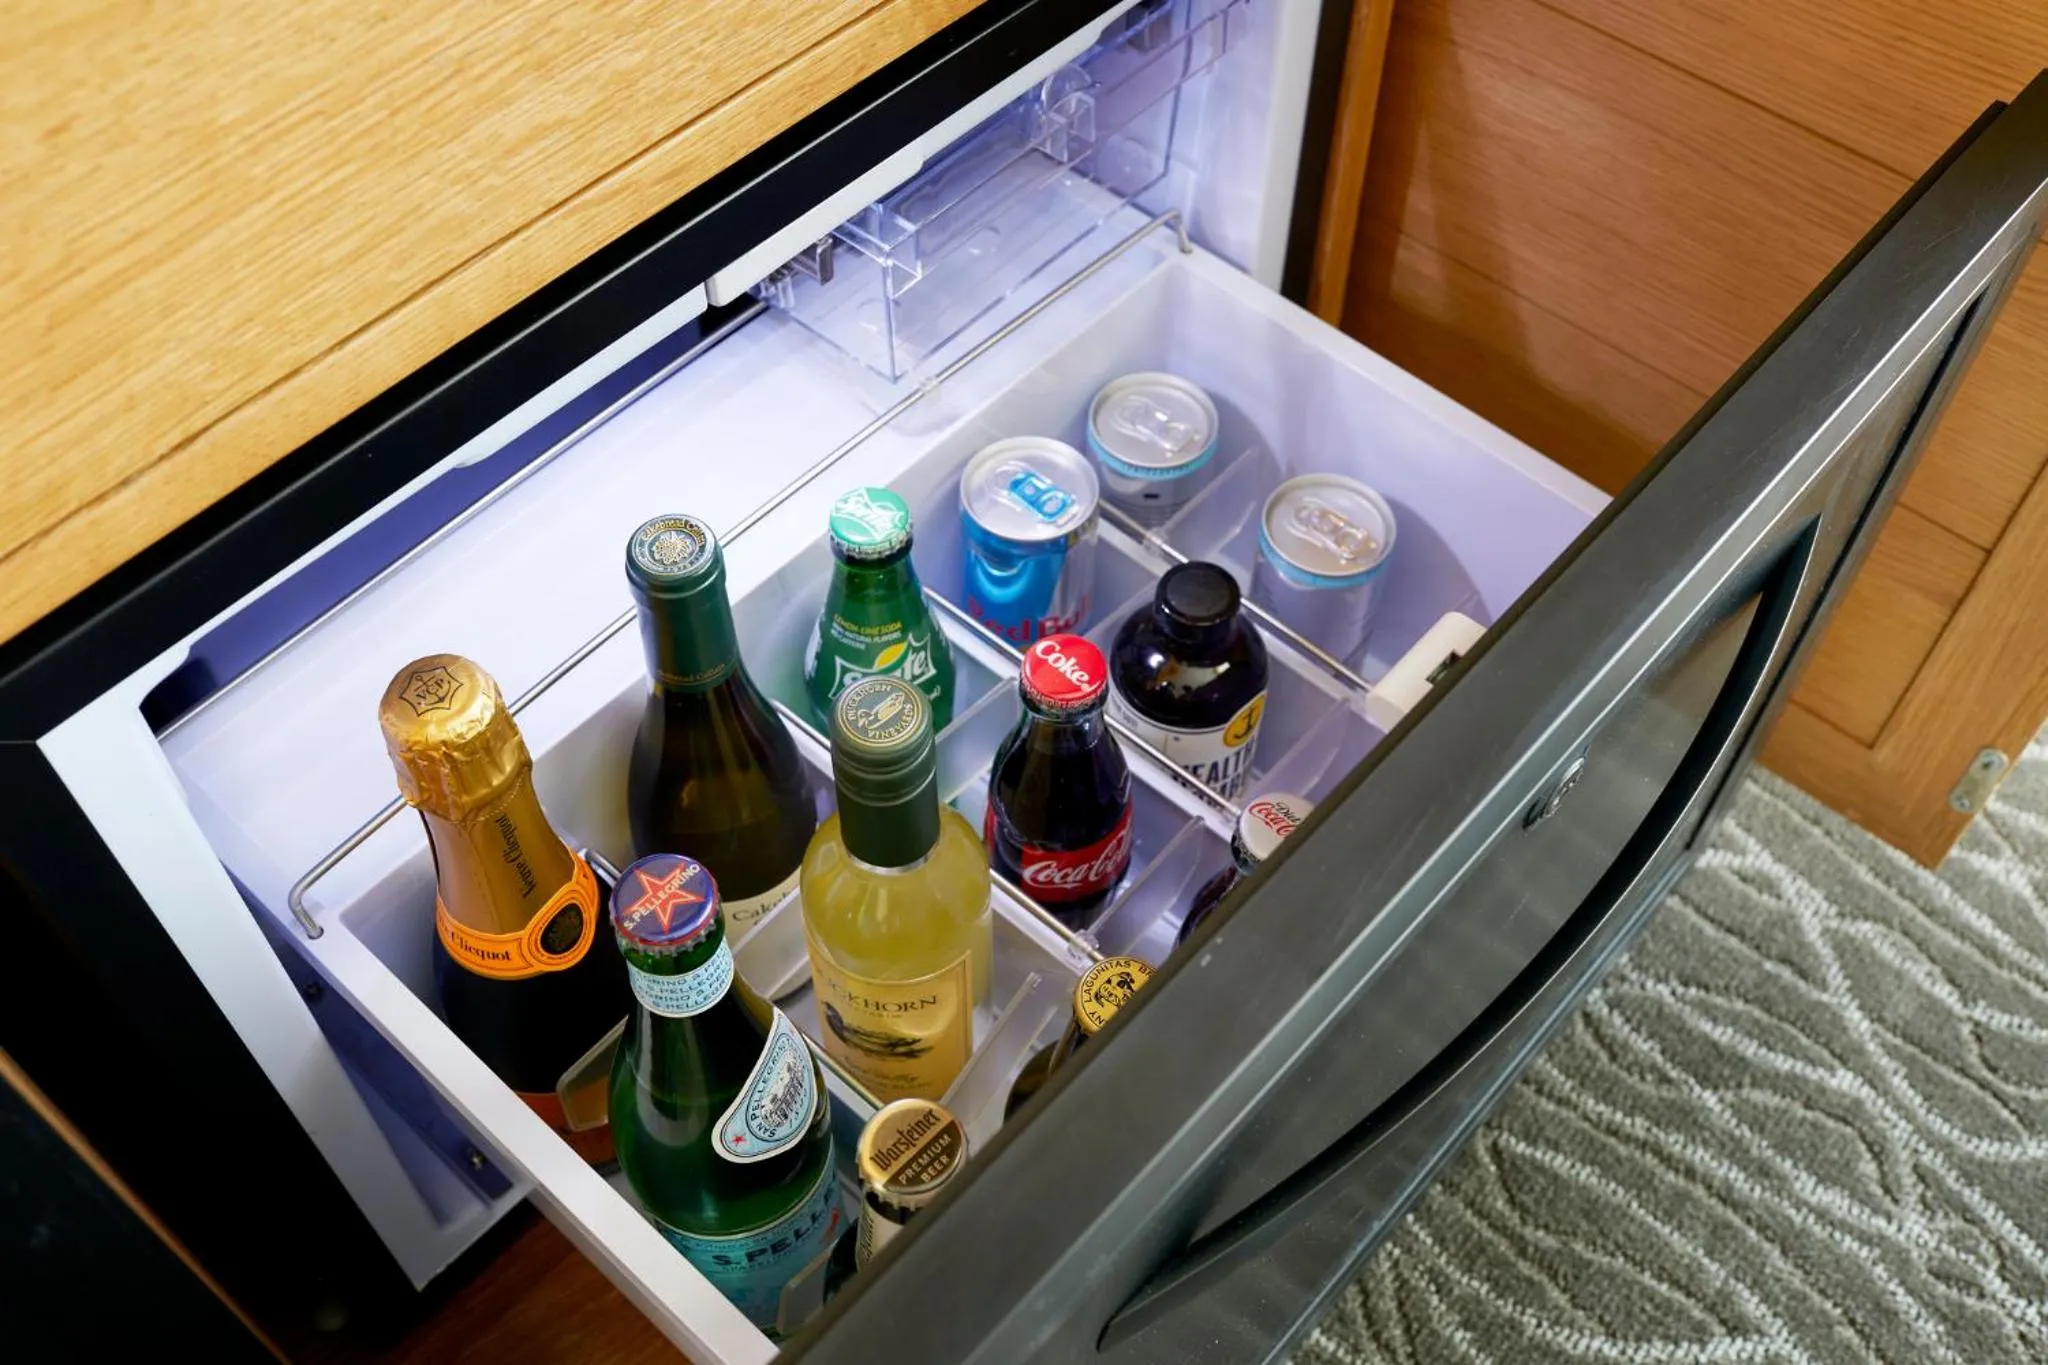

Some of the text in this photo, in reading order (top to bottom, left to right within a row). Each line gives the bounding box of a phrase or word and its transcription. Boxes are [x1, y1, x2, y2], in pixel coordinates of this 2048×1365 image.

[1036, 640, 1098, 692] Coke
[623, 863, 701, 930] S.PELLEGRINO
[1083, 960, 1132, 1004] LAGUNITAS
[756, 1122, 778, 1139] SAN
[869, 1107, 942, 1172] Warsteiner
[899, 1132, 952, 1185] PREMIUM
[920, 1154, 951, 1184] BEER
